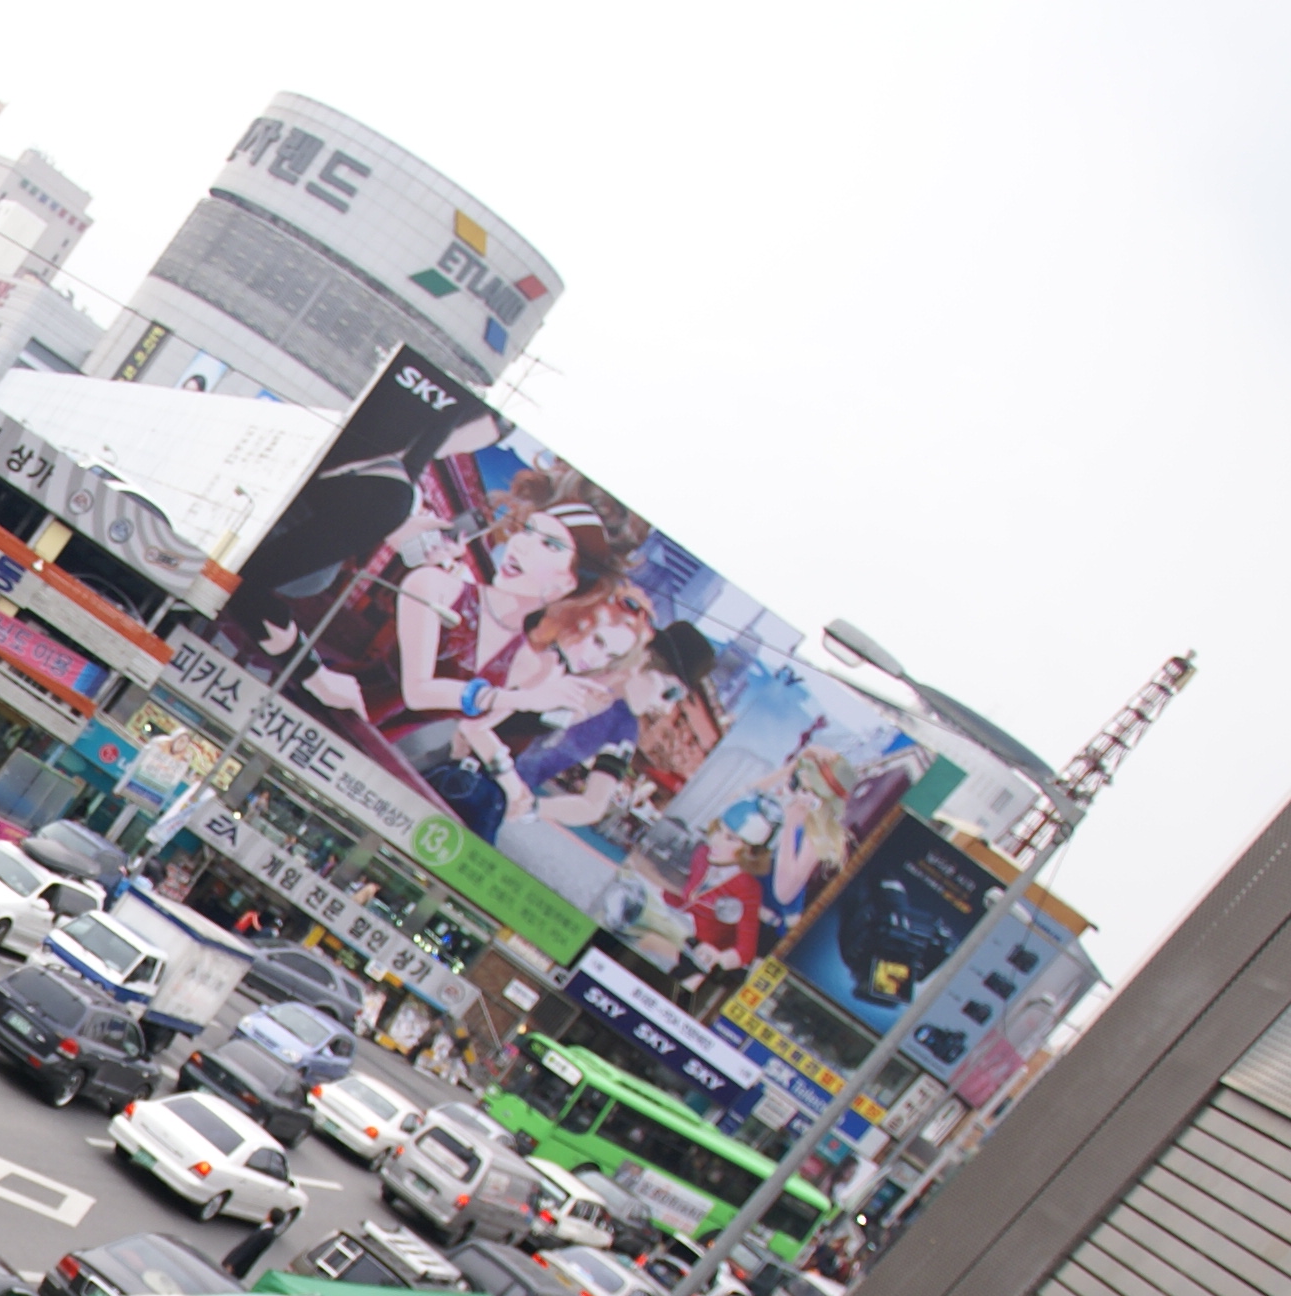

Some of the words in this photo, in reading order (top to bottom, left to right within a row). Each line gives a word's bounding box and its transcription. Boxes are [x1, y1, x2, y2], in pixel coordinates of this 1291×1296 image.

[436, 241, 526, 327] ETLAND
[394, 366, 458, 412] SKY
[5, 443, 56, 491] 상가
[31, 641, 75, 679] 이용
[169, 642, 247, 714] 피카소
[248, 695, 347, 783] 전자월드
[335, 769, 415, 836] 전문도매상가
[203, 816, 239, 847] EA
[261, 851, 305, 892] 게임
[303, 884, 347, 924] 전문
[346, 913, 393, 953] 할인
[389, 947, 433, 984] 상가
[581, 986, 628, 1023] SKY
[632, 1020, 677, 1056] SKY
[681, 1055, 727, 1093] SKY
[761, 1055, 797, 1088] SK
